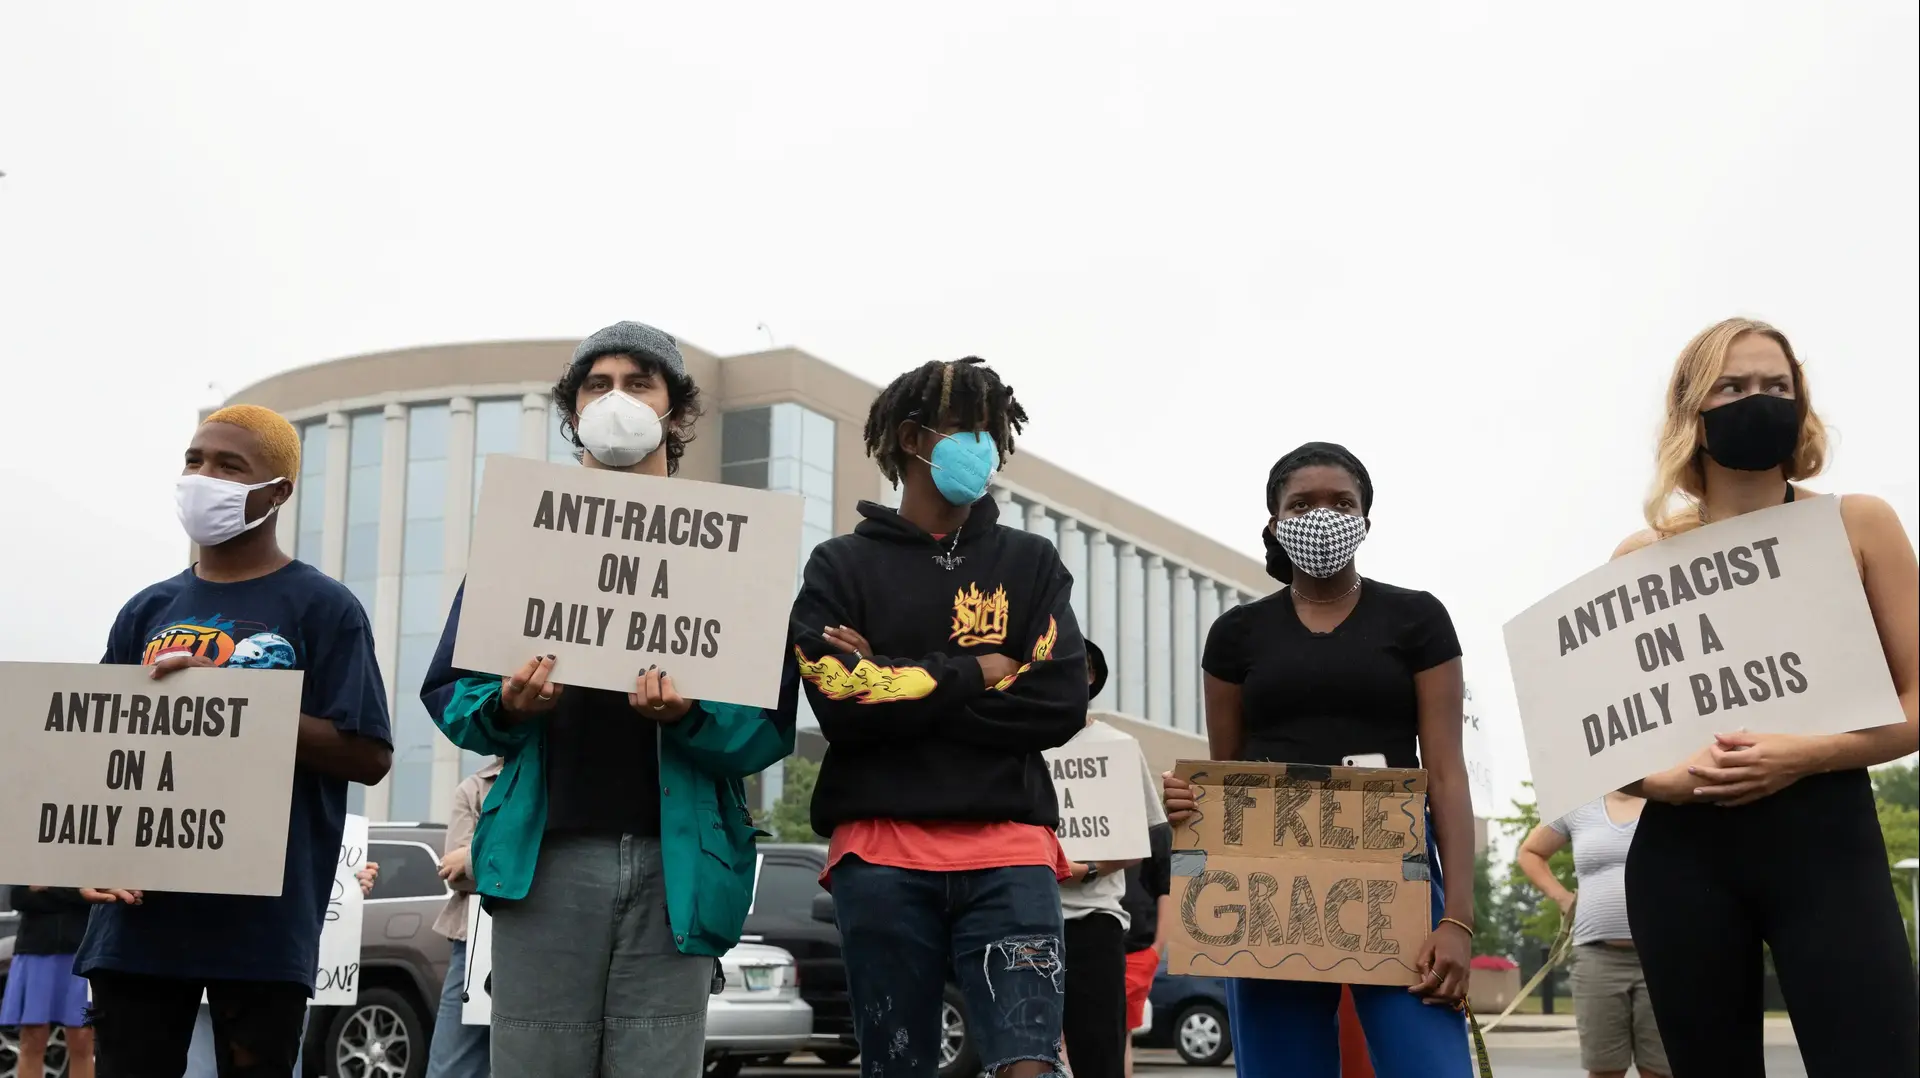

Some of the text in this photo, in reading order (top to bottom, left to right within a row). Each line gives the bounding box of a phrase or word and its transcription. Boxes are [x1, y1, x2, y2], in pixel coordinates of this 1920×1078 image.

[533, 490, 749, 553] ANTI-RACIST
[597, 553, 669, 599] ON A
[1557, 536, 1781, 657] ANTI-RACIST
[523, 597, 721, 659] DAILY BASIS
[1634, 612, 1725, 673] ON A
[44, 691, 249, 738] ANTI-RACIST
[1581, 651, 1809, 757] DAILY BASIS
[106, 749, 174, 792] ON A
[1064, 787, 1075, 809] A
[37, 802, 226, 851] DAILY BASIS
[1057, 815, 1110, 839] BASIS
[1222, 773, 1405, 850] FREE
[1181, 870, 1400, 955] GRACE
